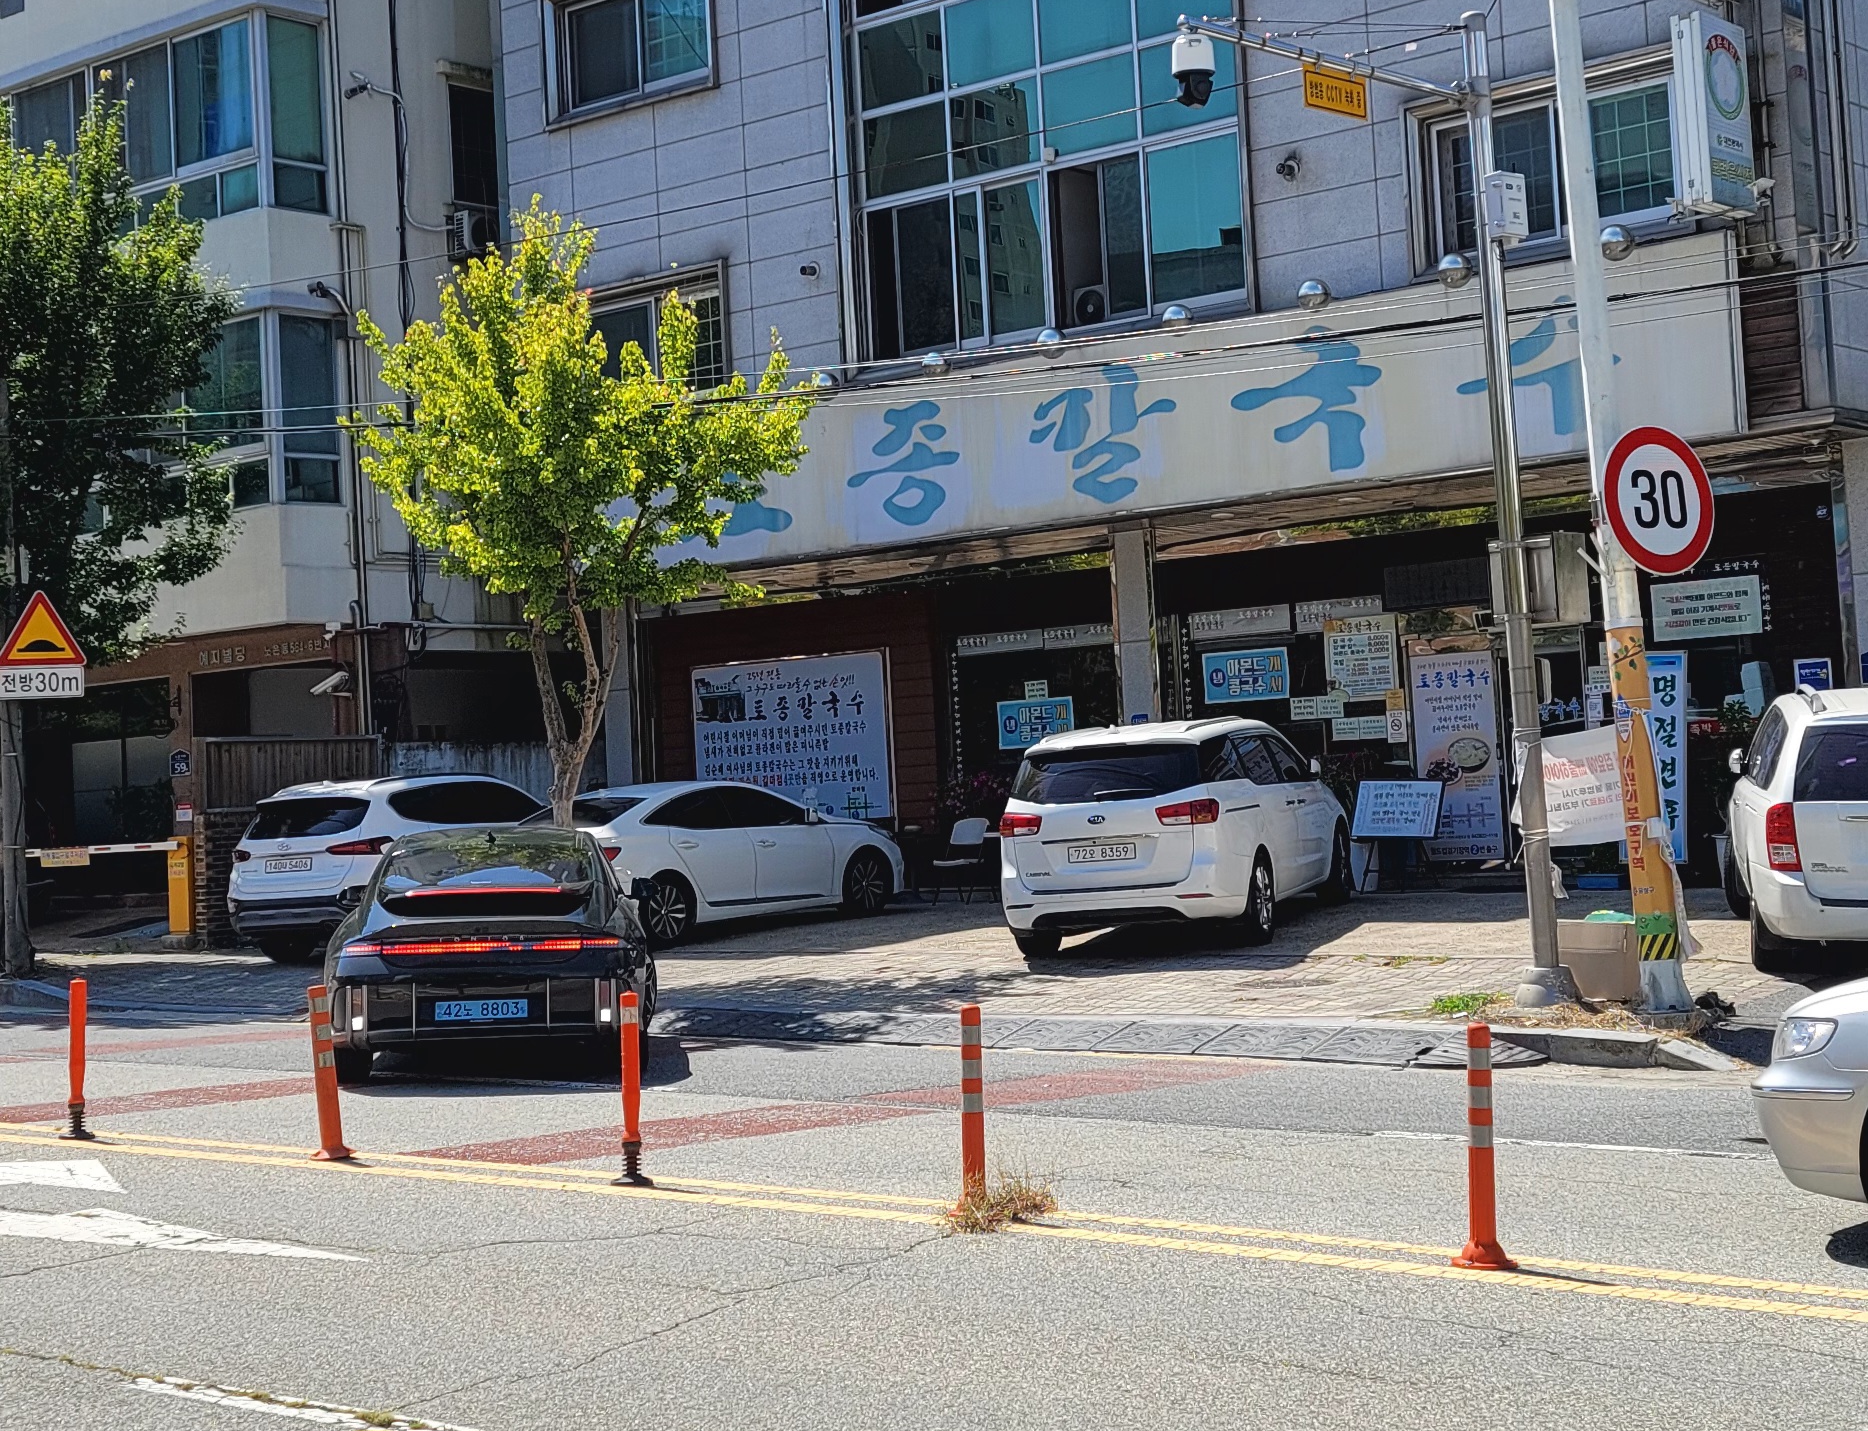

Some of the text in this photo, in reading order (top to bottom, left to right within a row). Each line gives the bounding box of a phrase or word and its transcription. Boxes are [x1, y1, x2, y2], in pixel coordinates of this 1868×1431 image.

[1631, 469, 1688, 530] 30
[1227, 656, 1265, 676] 아몬드
[1, 671, 79, 693] 전방30m
[1228, 676, 1268, 696] 콩국수
[1416, 668, 1490, 689] 토종칼국수
[748, 689, 865, 721] 토종칼국수
[1018, 705, 1053, 723] 아몬드
[830, 720, 867, 735] 토종칼국수
[755, 758, 795, 774] 토종칼국수는
[1100, 846, 1129, 858] 8359
[442, 1001, 520, 1018] 42노 8803
